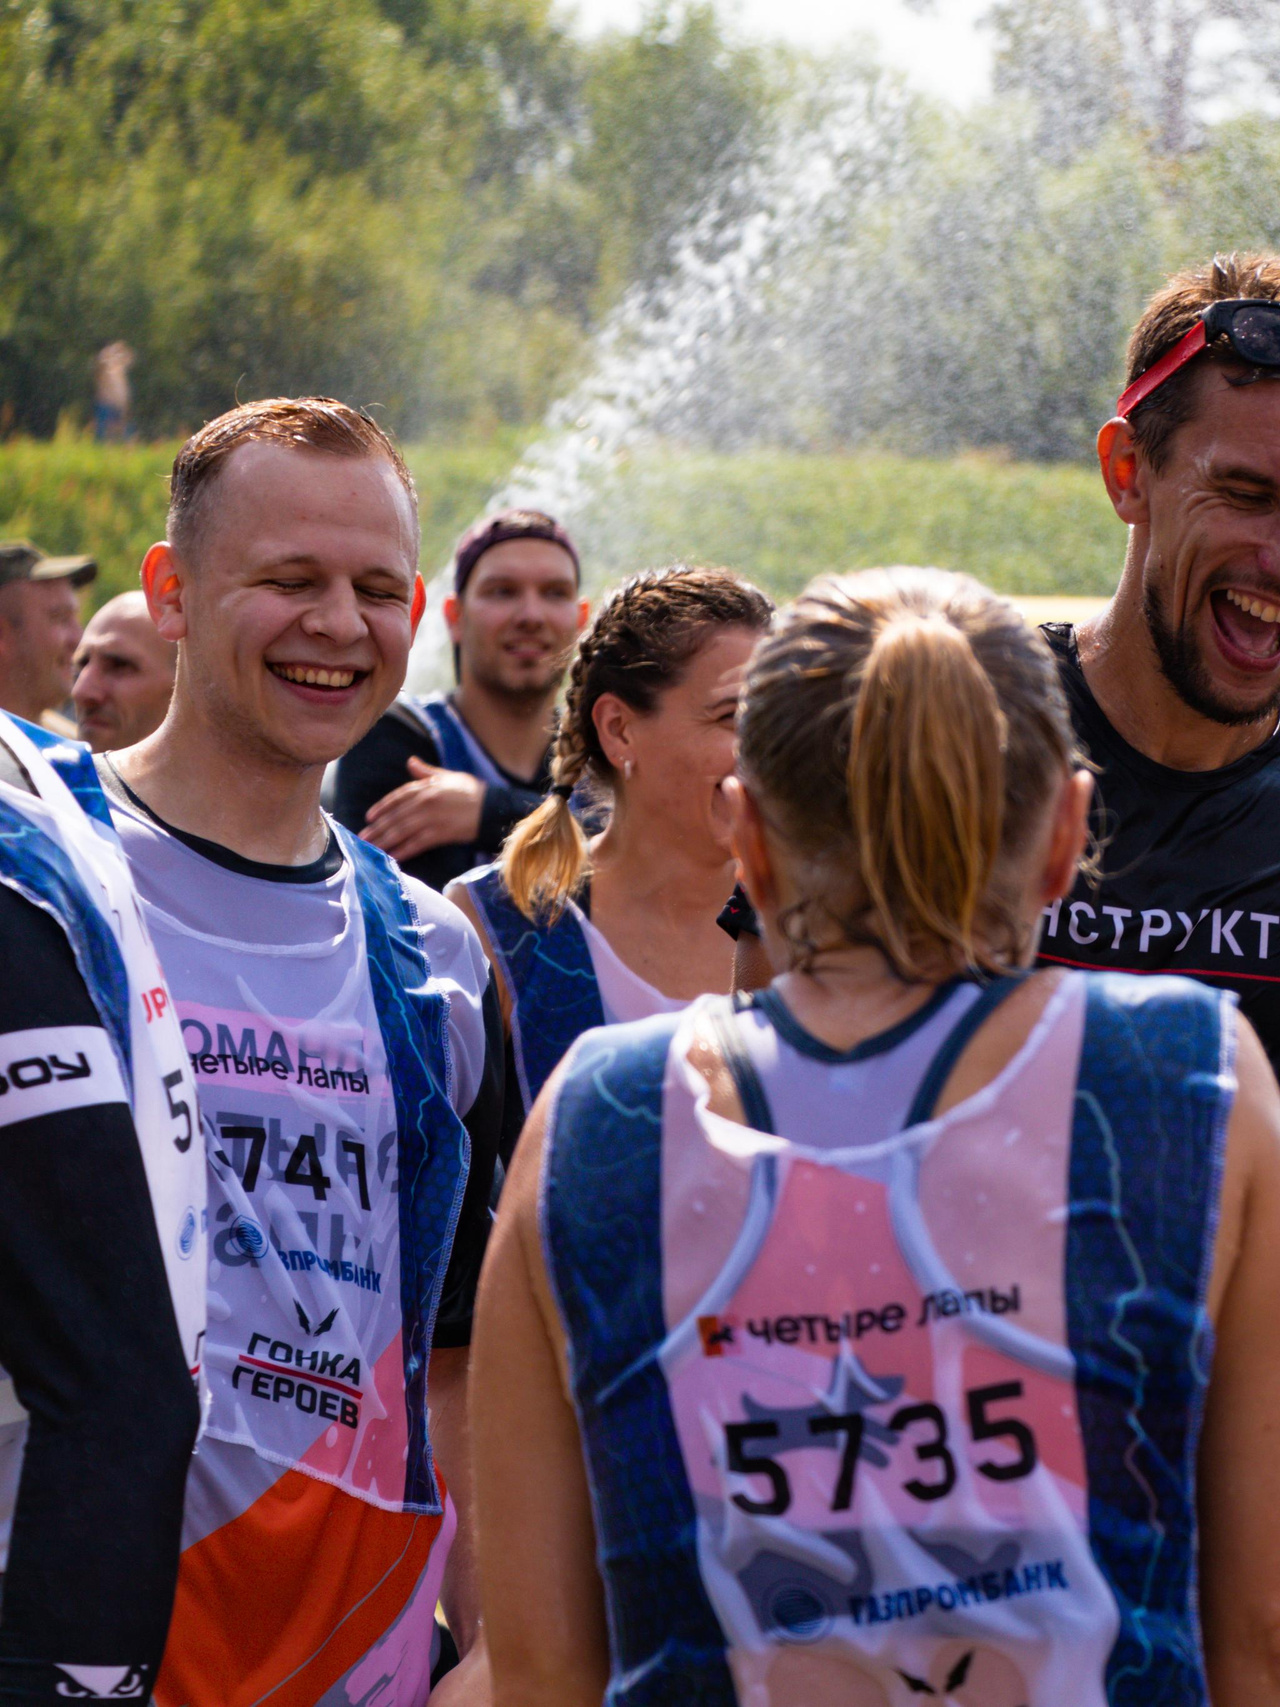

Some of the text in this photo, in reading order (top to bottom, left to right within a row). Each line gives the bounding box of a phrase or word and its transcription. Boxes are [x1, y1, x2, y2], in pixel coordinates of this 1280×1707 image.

[296, 1064, 370, 1094] лапы
[212, 1126, 371, 1212] 741
[746, 1283, 1020, 1344] четыре лапы
[247, 1332, 361, 1386] ГОНКА
[232, 1365, 359, 1429] ГЕРОЕВ
[724, 1379, 1037, 1517] 5735
[850, 1558, 1069, 1626] ГАЗПРОМБАНК
